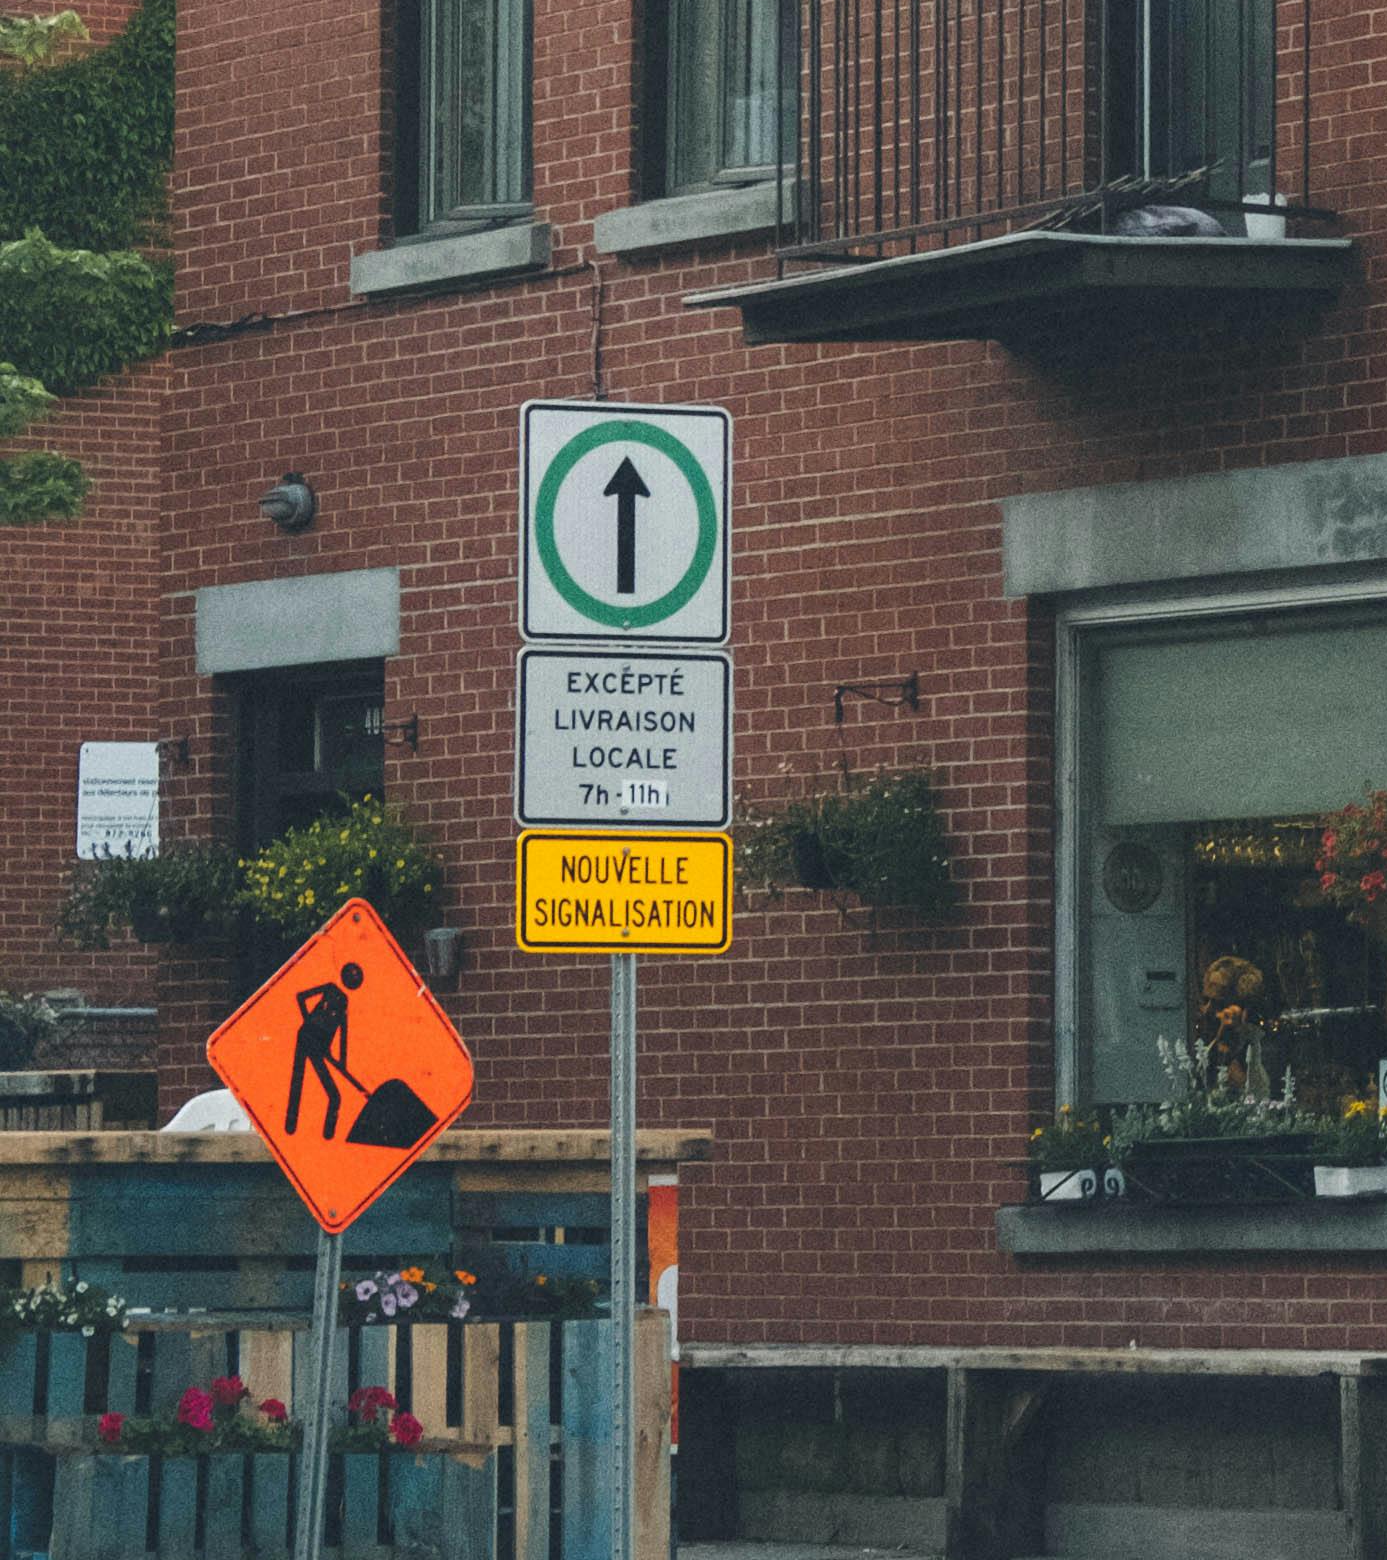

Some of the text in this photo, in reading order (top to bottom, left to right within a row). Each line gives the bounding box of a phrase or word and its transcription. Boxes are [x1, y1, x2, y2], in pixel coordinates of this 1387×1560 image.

[554, 709, 696, 733] LIVRAISON
[572, 746, 678, 770] LOCALE
[579, 783, 609, 805] 7h
[629, 783, 660, 805] 11h
[561, 855, 689, 885] NOUVELLE
[534, 898, 715, 929] SIGNALISATION
